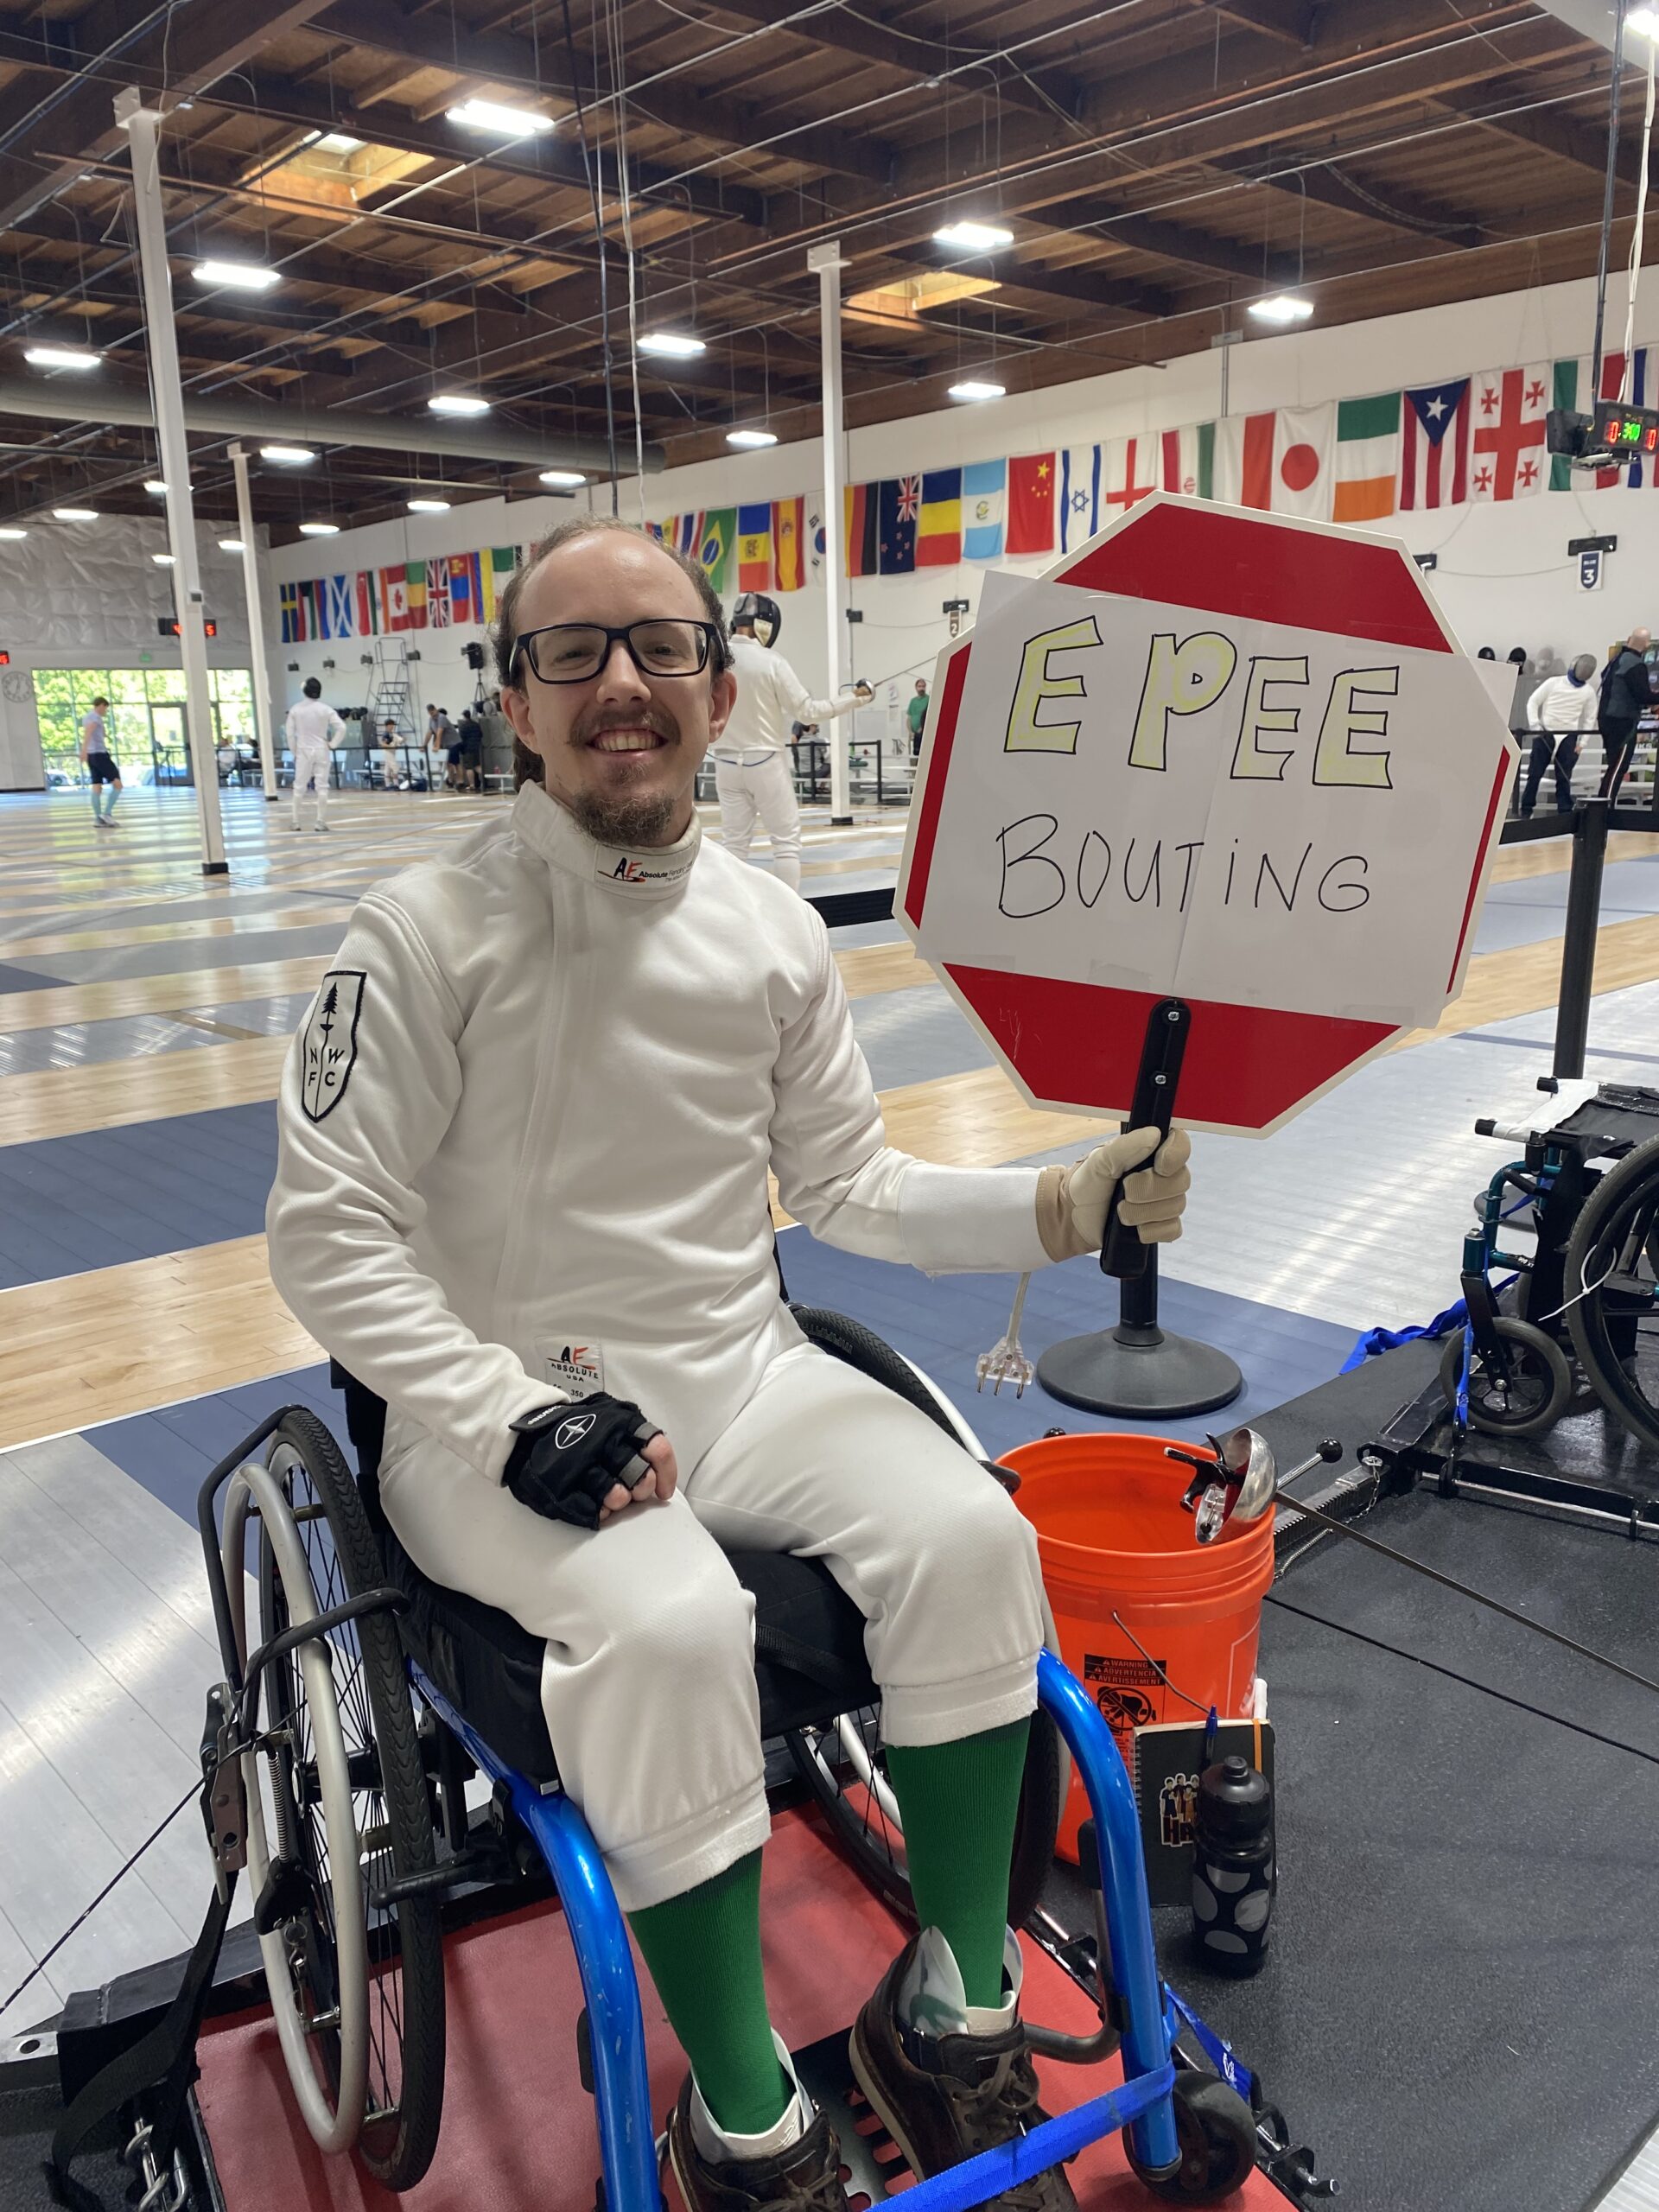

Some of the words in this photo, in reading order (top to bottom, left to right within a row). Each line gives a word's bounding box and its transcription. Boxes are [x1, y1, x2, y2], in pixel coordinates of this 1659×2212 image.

[1583, 569, 1595, 584] 3
[950, 623, 957, 633] 2
[1004, 615, 1401, 790] EPEE
[613, 857, 643, 880] AF
[561, 1346, 588, 1365] AF
[551, 1363, 599, 1379] ABSOLUTE
[570, 1389, 584, 1398] 350
[1110, 1660, 1148, 1669] WARNING
[1103, 1668, 1156, 1676] ADVERTENCIA
[1098, 1675, 1160, 1685] AVERTISSEMENT
